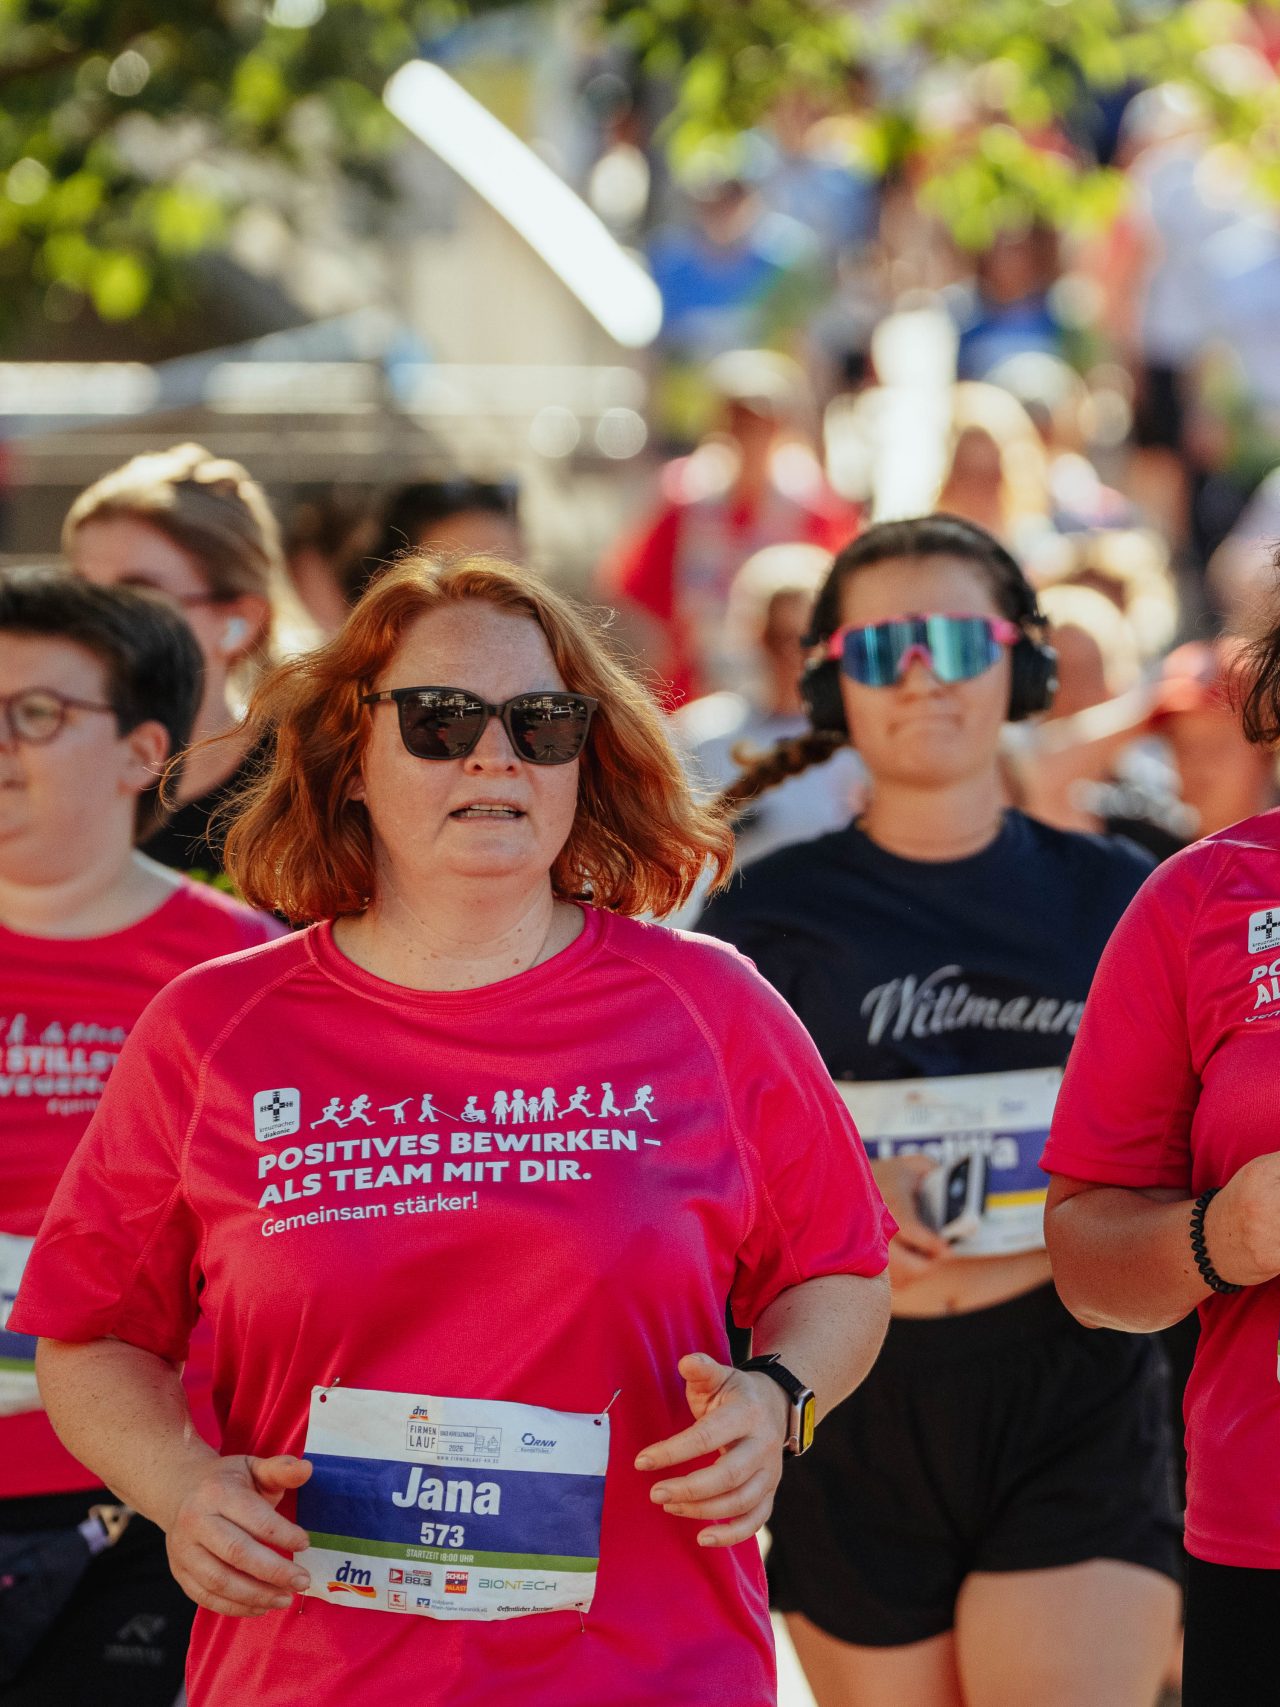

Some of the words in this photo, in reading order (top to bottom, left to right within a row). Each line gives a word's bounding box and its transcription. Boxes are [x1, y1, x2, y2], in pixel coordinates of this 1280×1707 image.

[263, 1128, 290, 1139] diakonie
[258, 1133, 440, 1179] POSITIVES
[450, 1129, 637, 1154] BEWIRKEN
[257, 1173, 322, 1209] ALS
[329, 1163, 432, 1192] TEAM
[443, 1160, 510, 1182] MIT
[519, 1159, 592, 1183] DIR.
[261, 1203, 386, 1237] Gemeinsam
[394, 1190, 478, 1216] stärker!
[412, 1405, 428, 1416] dm
[409, 1424, 437, 1436] FIRMEN
[409, 1436, 436, 1449] LAUF
[391, 1466, 501, 1516] Jana
[420, 1521, 465, 1548] 573
[405, 1548, 439, 1560] STARTZEIT
[459, 1554, 474, 1563] UHR
[335, 1560, 371, 1586] dm
[405, 1576, 432, 1587] 88.3
